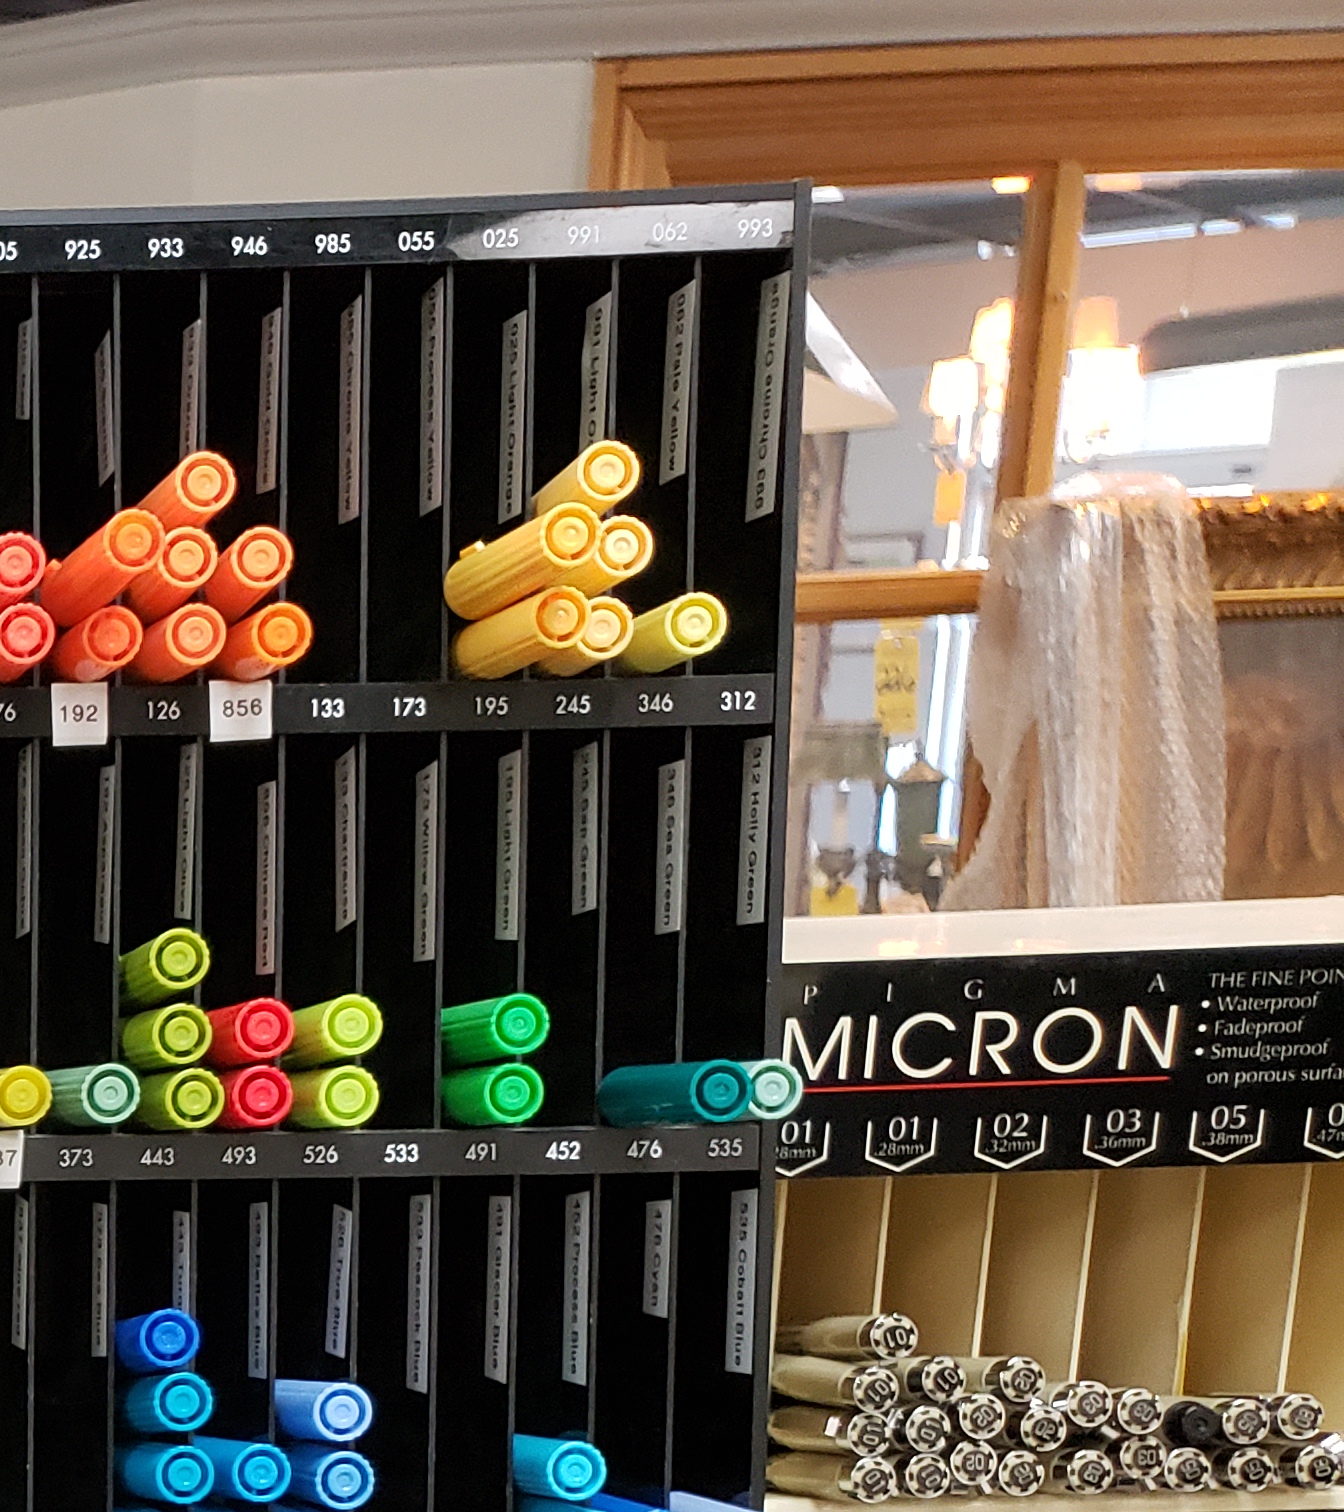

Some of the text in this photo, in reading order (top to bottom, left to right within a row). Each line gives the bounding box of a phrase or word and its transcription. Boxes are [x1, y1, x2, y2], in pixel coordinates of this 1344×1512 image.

[483, 229, 519, 248] 025
[567, 226, 601, 245] 991
[653, 223, 688, 241] 062
[738, 219, 773, 239] 993
[64, 240, 102, 260] 925
[231, 237, 267, 256] 946
[315, 234, 351, 254] 985
[398, 232, 435, 251] 055
[59, 705, 97, 723] 192
[147, 702, 181, 720] 126
[222, 699, 263, 718] 856
[1211, 969, 1295, 988] THE FINE
[1217, 991, 1321, 1014] Waterproof
[1215, 1016, 1306, 1038] Fadeproof
[783, 1004, 1178, 1080] MICRON
[1211, 1038, 1331, 1062] Smudgeproof
[1207, 1069, 1295, 1088] on porous
[994, 1113, 1029, 1138] 02
[1107, 1109, 1141, 1134] 03
[1212, 1105, 1248, 1129] 05
[889, 1116, 919, 1141] 01
[140, 1148, 175, 1166] 443
[384, 1143, 419, 1163] 533
[545, 1142, 582, 1161] 452
